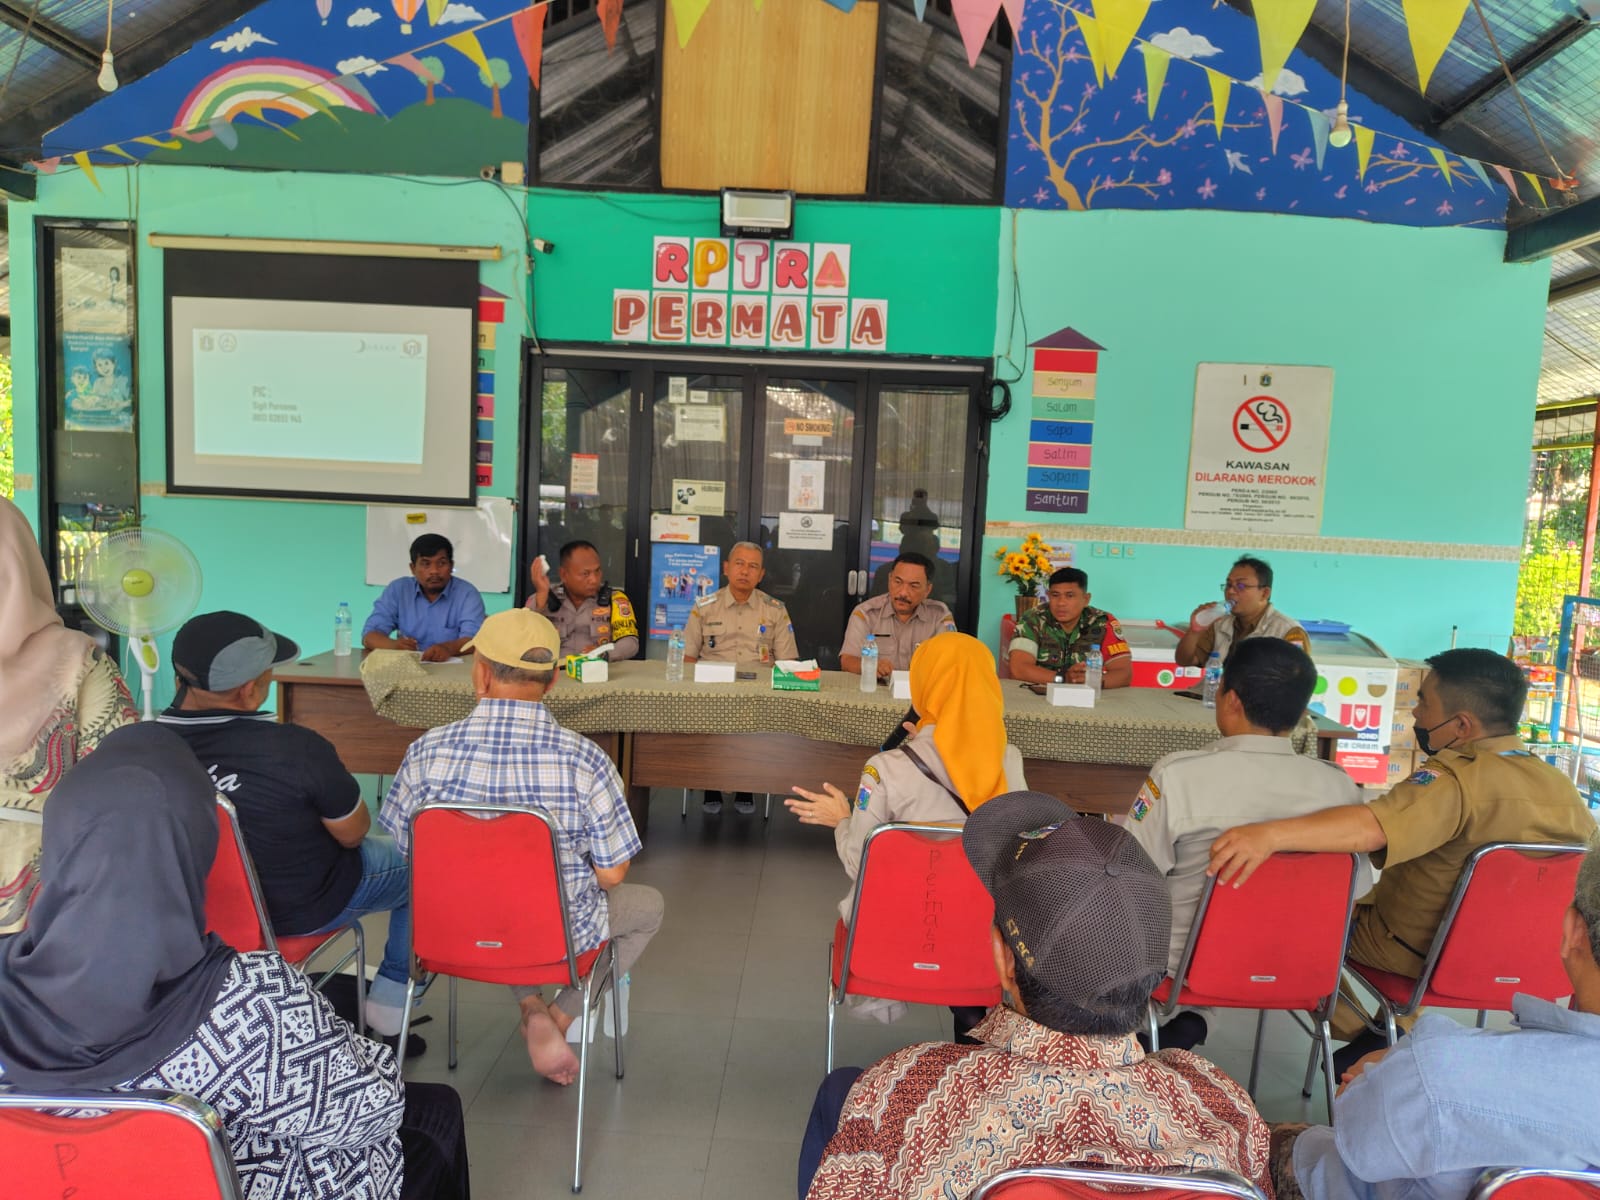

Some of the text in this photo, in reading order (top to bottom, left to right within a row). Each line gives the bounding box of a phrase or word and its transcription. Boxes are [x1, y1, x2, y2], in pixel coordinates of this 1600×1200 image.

[655, 240, 847, 289] RPTRA
[613, 293, 884, 345] PERMATA
[796, 422, 805, 431] NO
[1226, 460, 1290, 471] KAWASAN
[1195, 472, 1316, 486] DILARANG MEROKOK
